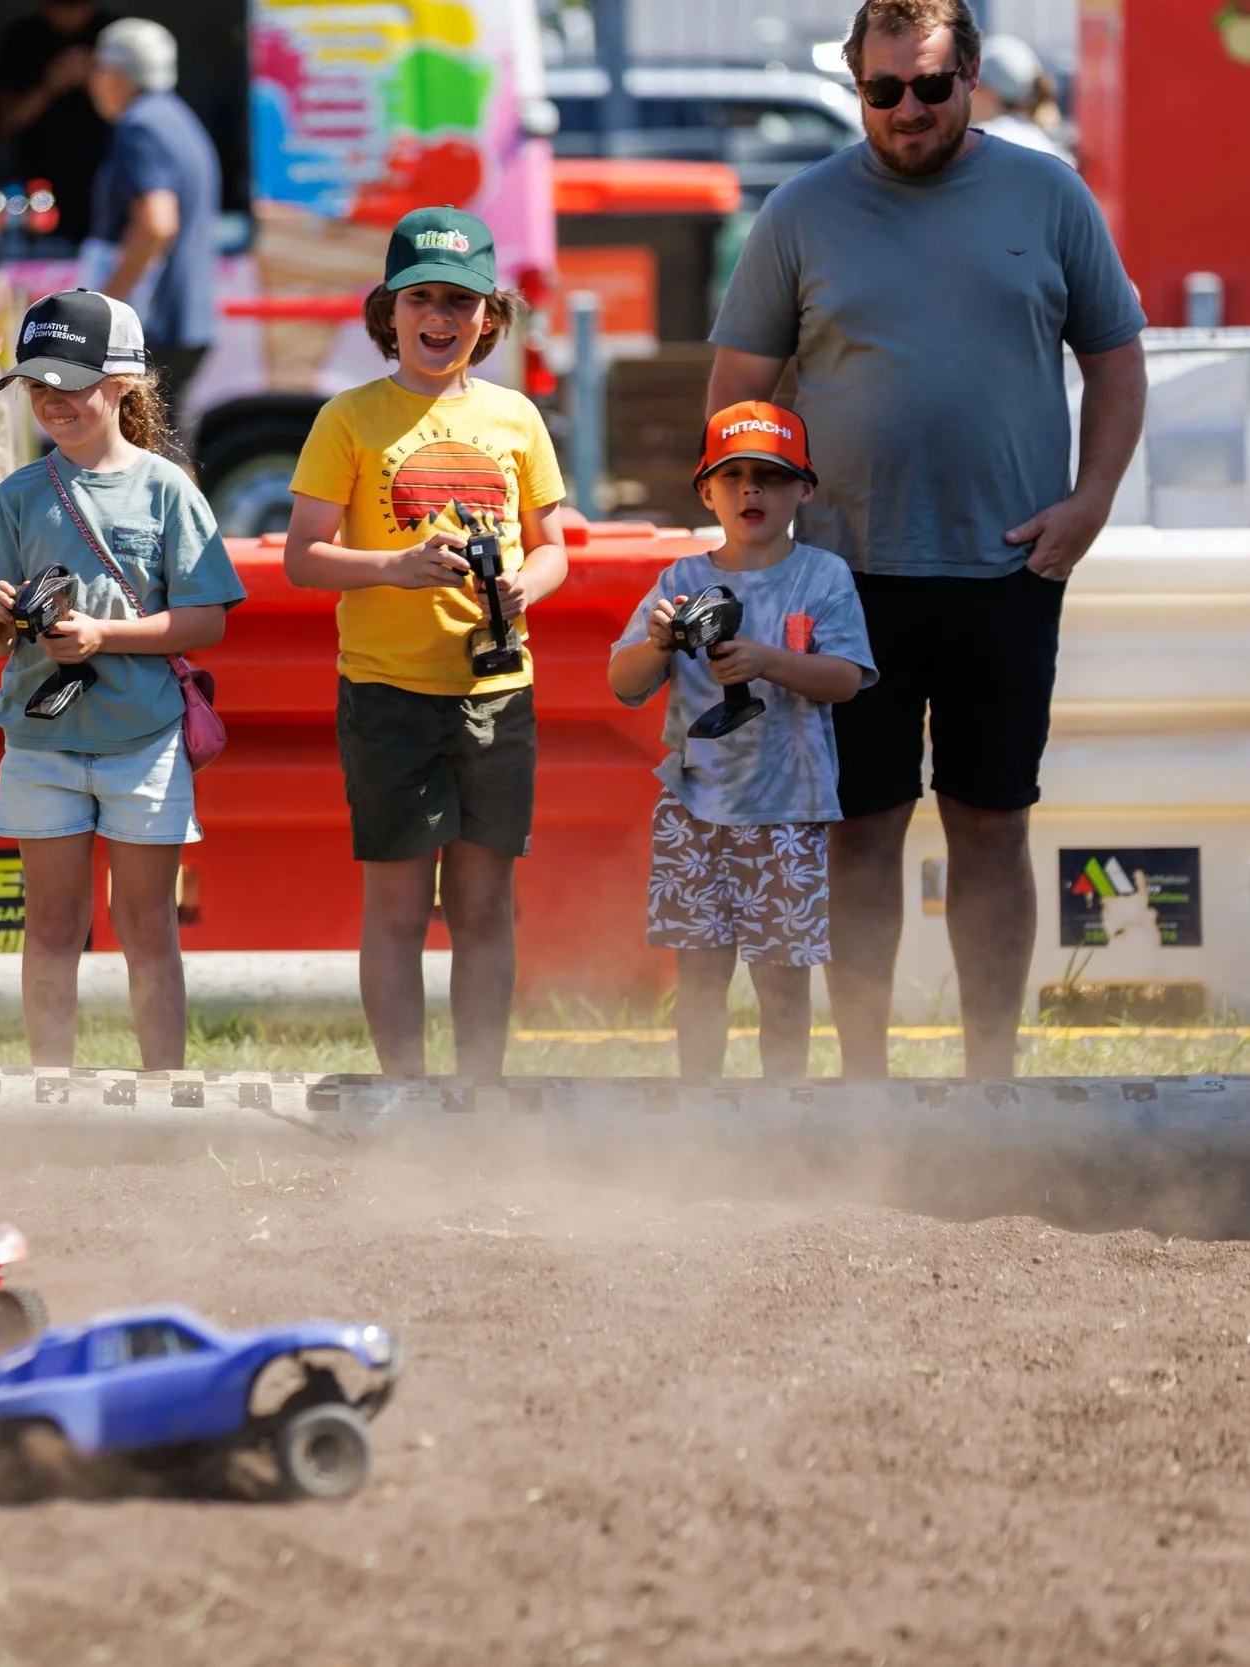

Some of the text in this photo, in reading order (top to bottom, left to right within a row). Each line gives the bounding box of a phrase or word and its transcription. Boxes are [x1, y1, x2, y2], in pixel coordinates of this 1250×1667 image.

[36, 322, 70, 332] CREATIVE
[34, 331, 87, 344] CONVERSIONS
[722, 419, 792, 440] HITACHI
[380, 446, 406, 534] EXPLORE
[419, 429, 452, 442] THE
